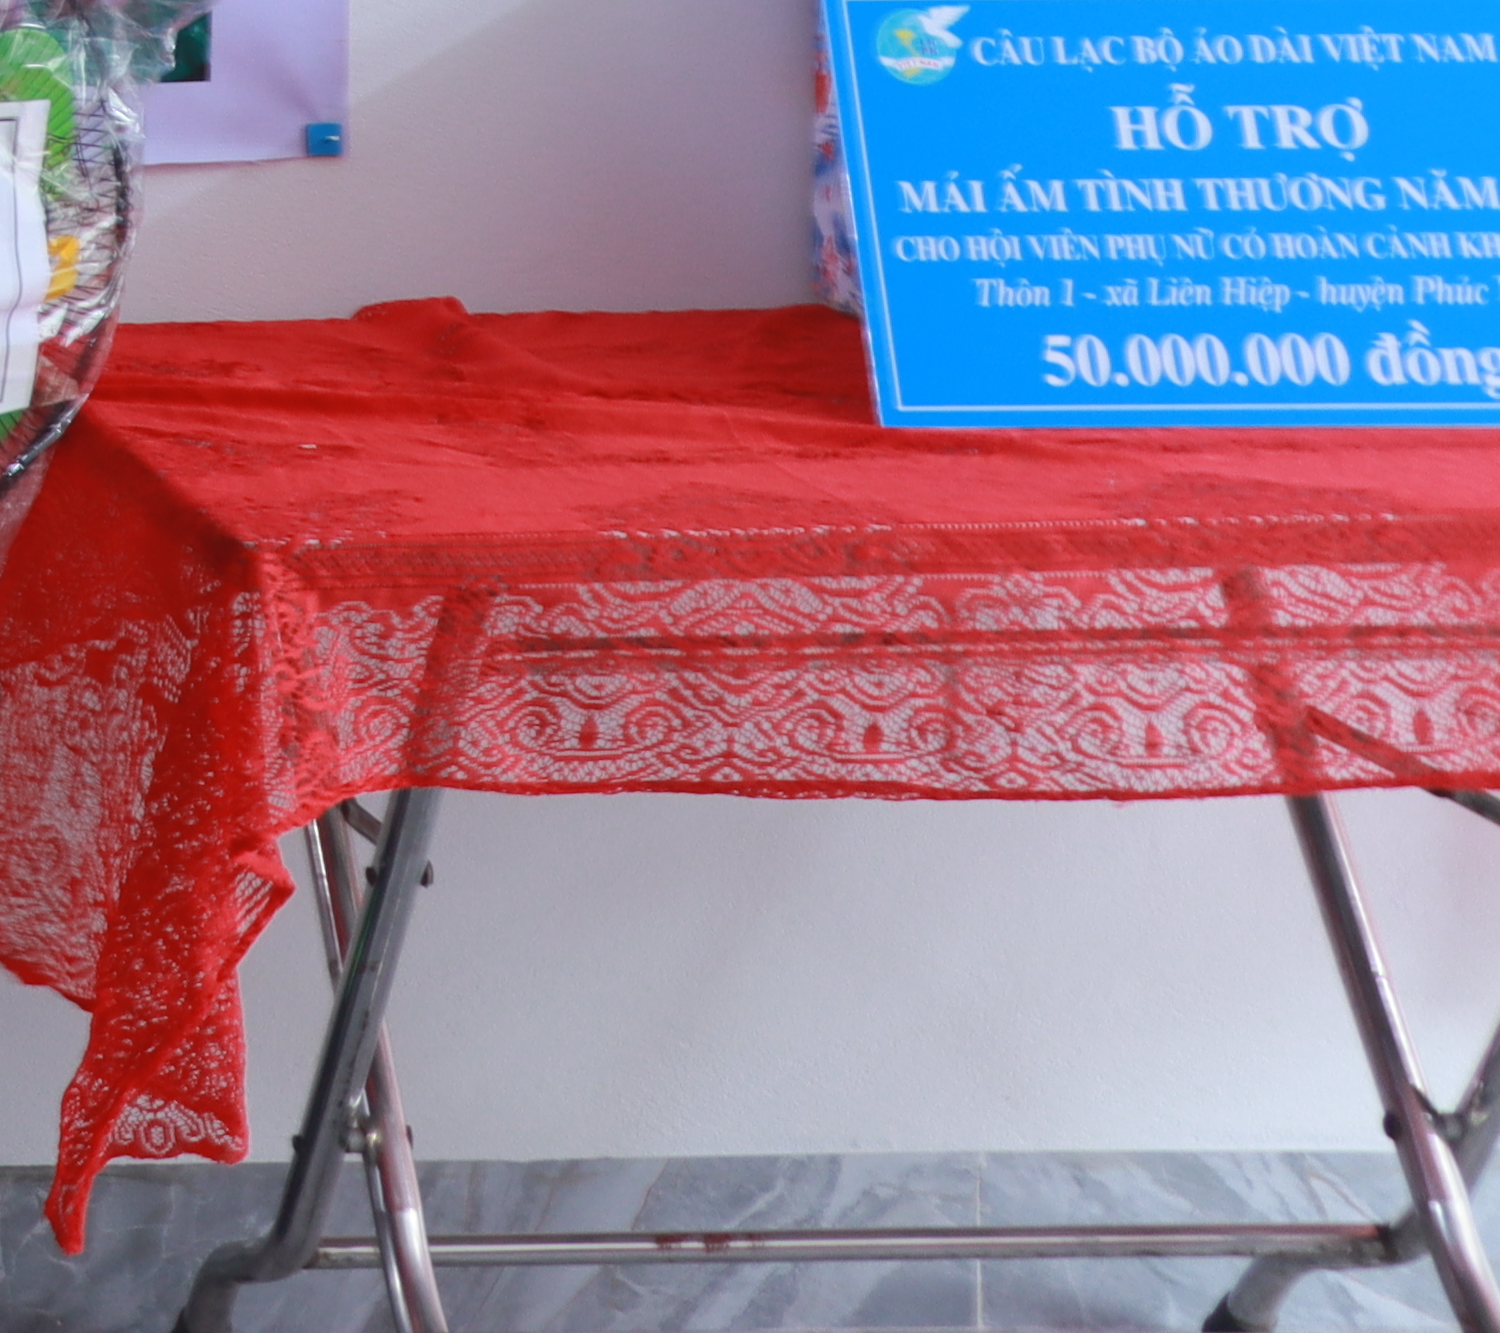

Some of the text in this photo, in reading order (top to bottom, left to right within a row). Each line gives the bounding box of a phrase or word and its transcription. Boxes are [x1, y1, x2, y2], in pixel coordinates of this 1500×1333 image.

[970, 27, 1046, 66] CÂU
[1052, 34, 1126, 74] LẠC
[1134, 27, 1184, 71] BỘ
[1193, 27, 1244, 65] ÁO
[1248, 27, 1313, 64] DÀI
[1325, 25, 1403, 70] VIỆT
[1404, 33, 1497, 64] NAM
[1110, 83, 1371, 161] HỖ TRỢ
[896, 163, 1500, 213] MÁI ẤM TÌNH THƯƠNG NĂM
[894, 234, 960, 263] CHO
[966, 227, 1023, 268] HỘI
[1025, 227, 1100, 261] VIÊN
[1103, 233, 1167, 267] PHỤ
[1170, 226, 1216, 261] NỮ
[1219, 225, 1267, 261] CÓ
[1270, 225, 1360, 259] HOÀN
[1364, 224, 1453, 259] CẢNH
[973, 277, 1051, 308] Thôn
[1060, 278, 1075, 307] 1
[1104, 278, 1139, 307] xã
[1146, 276, 1213, 307] Liên
[1220, 276, 1291, 314] Hiệp
[1315, 275, 1405, 314] huyện
[1411, 274, 1490, 306] Phúc
[1043, 333, 1351, 387] 50.000.000
